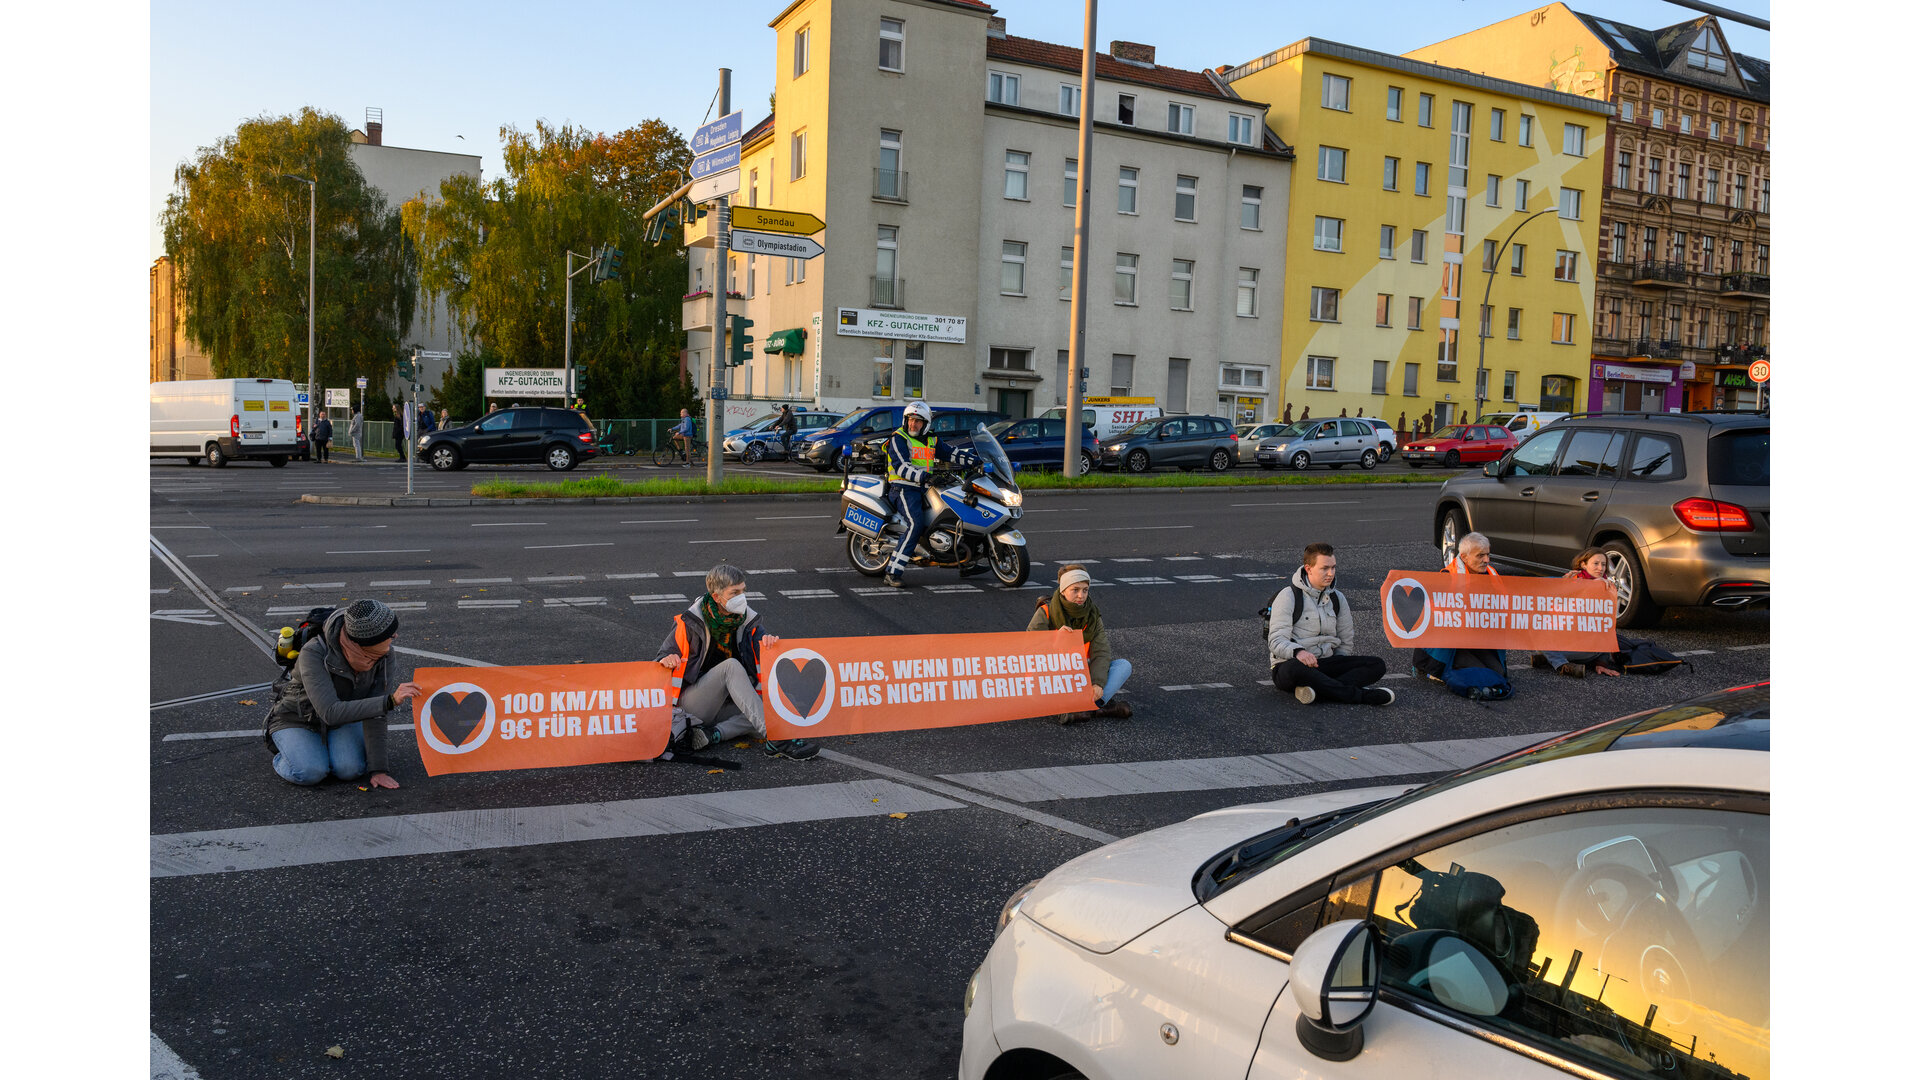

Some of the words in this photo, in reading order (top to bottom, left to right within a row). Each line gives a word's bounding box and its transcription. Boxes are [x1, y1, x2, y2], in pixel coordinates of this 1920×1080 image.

[710, 122, 727, 135] Dresden
[757, 215, 795, 227] Spandau
[757, 239, 807, 253] Olympiastadion
[880, 312, 914, 320] INGENIEURBÜRO
[867, 320, 884, 328] KFZ
[890, 321, 940, 332] GUTACHTEN
[1753, 366, 1767, 377] 30
[498, 376, 563, 386] KFZ-GUTACHTEN
[1724, 373, 1746, 387] AHSA
[1112, 410, 1148, 424] SHL
[848, 510, 879, 530] POLIZEI
[1432, 592, 1467, 610] WAS,
[1469, 594, 1509, 610] WENN
[1512, 595, 1534, 611] DIE
[1537, 596, 1614, 615] REGIERUNG
[1434, 611, 1462, 628] DAS
[1465, 611, 1508, 629] NICHT
[1510, 613, 1529, 630] IM
[1532, 614, 1574, 631] GRIFF
[1577, 616, 1613, 633] HAT?
[838, 660, 889, 682] WAS,
[892, 658, 948, 680] WENN
[952, 655, 982, 677] DIE
[985, 652, 1085, 675] REGIERUNG
[839, 685, 883, 707] DAS
[886, 681, 948, 704] NICHT
[952, 679, 978, 701] IM
[982, 676, 1035, 698] GRIFF
[1038, 673, 1088, 695] HAT?
[500, 692, 545, 715] 100
[551, 690, 614, 712] KM/H
[619, 688, 666, 709] UND
[500, 718, 533, 740] 9€
[538, 713, 582, 738] FÜR
[587, 714, 638, 736] ALLE
